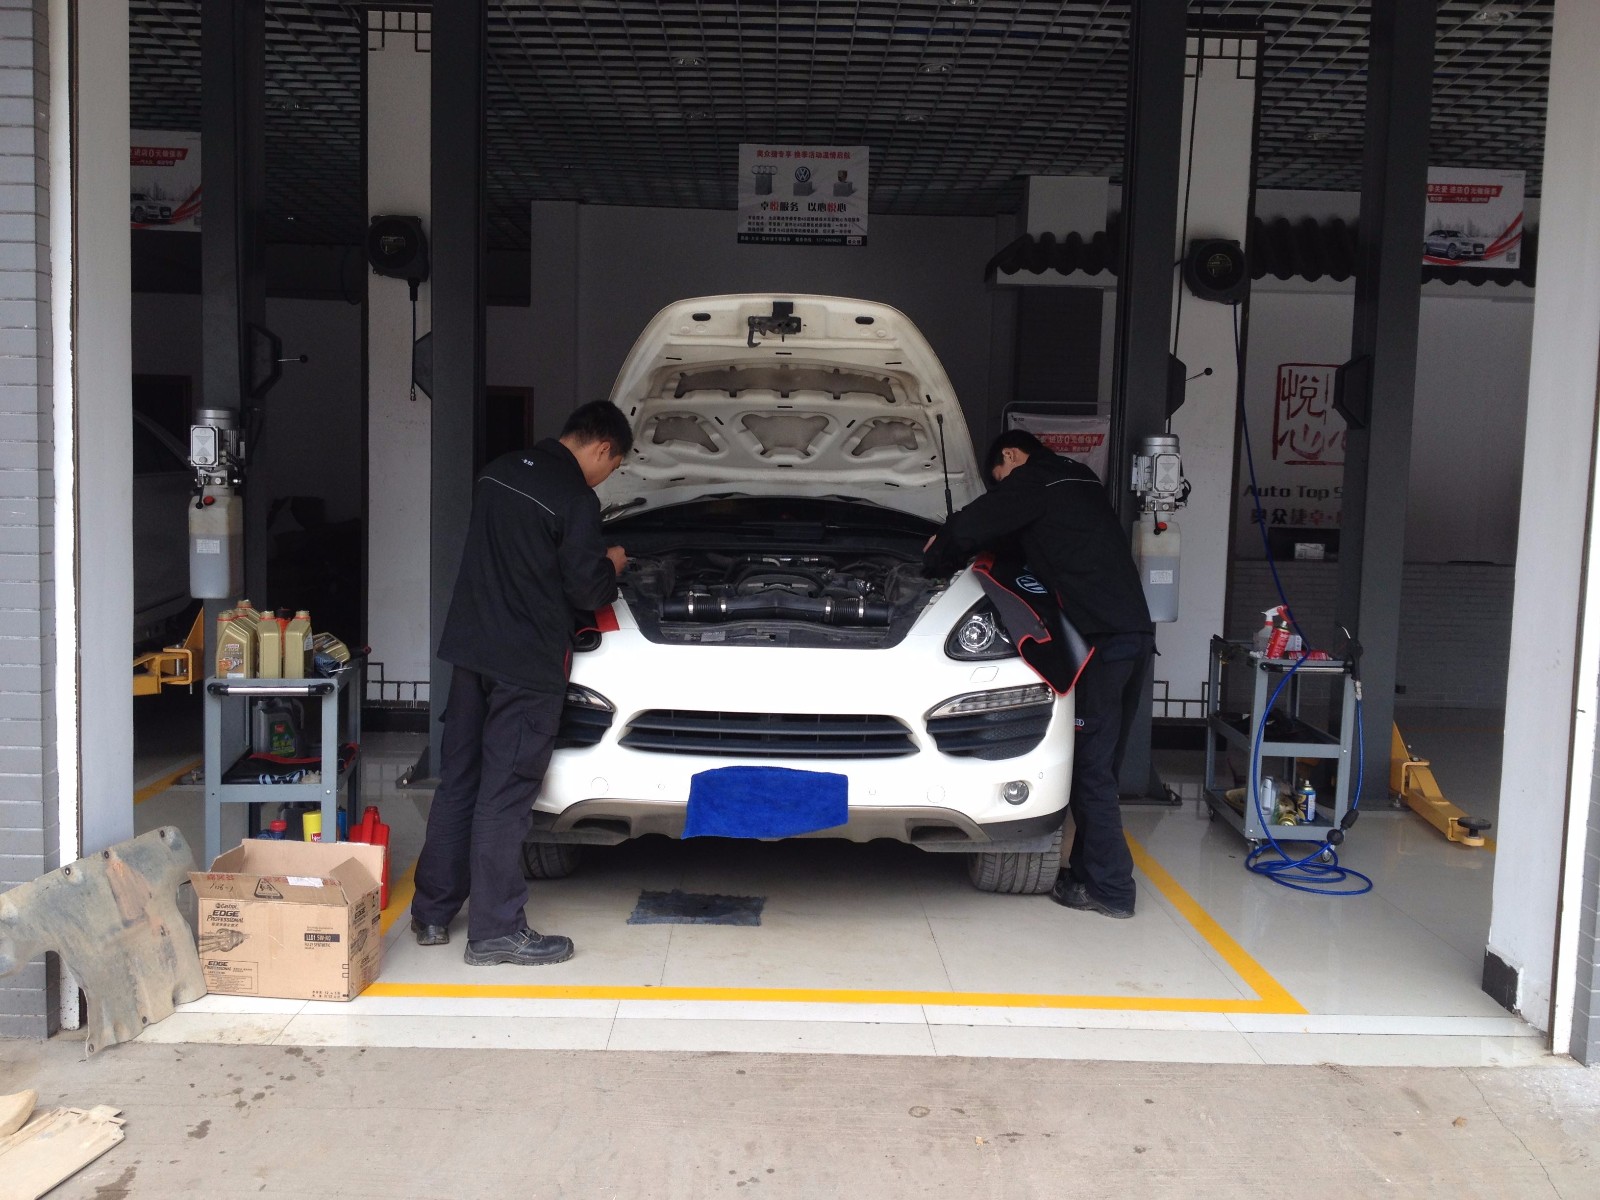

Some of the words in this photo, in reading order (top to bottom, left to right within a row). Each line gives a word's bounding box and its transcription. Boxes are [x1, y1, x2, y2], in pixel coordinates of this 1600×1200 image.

[808, 202, 847, 213] 以心悦心
[1243, 485, 1290, 498] Auto
[1296, 485, 1329, 501] Top
[212, 909, 240, 917] EDGE
